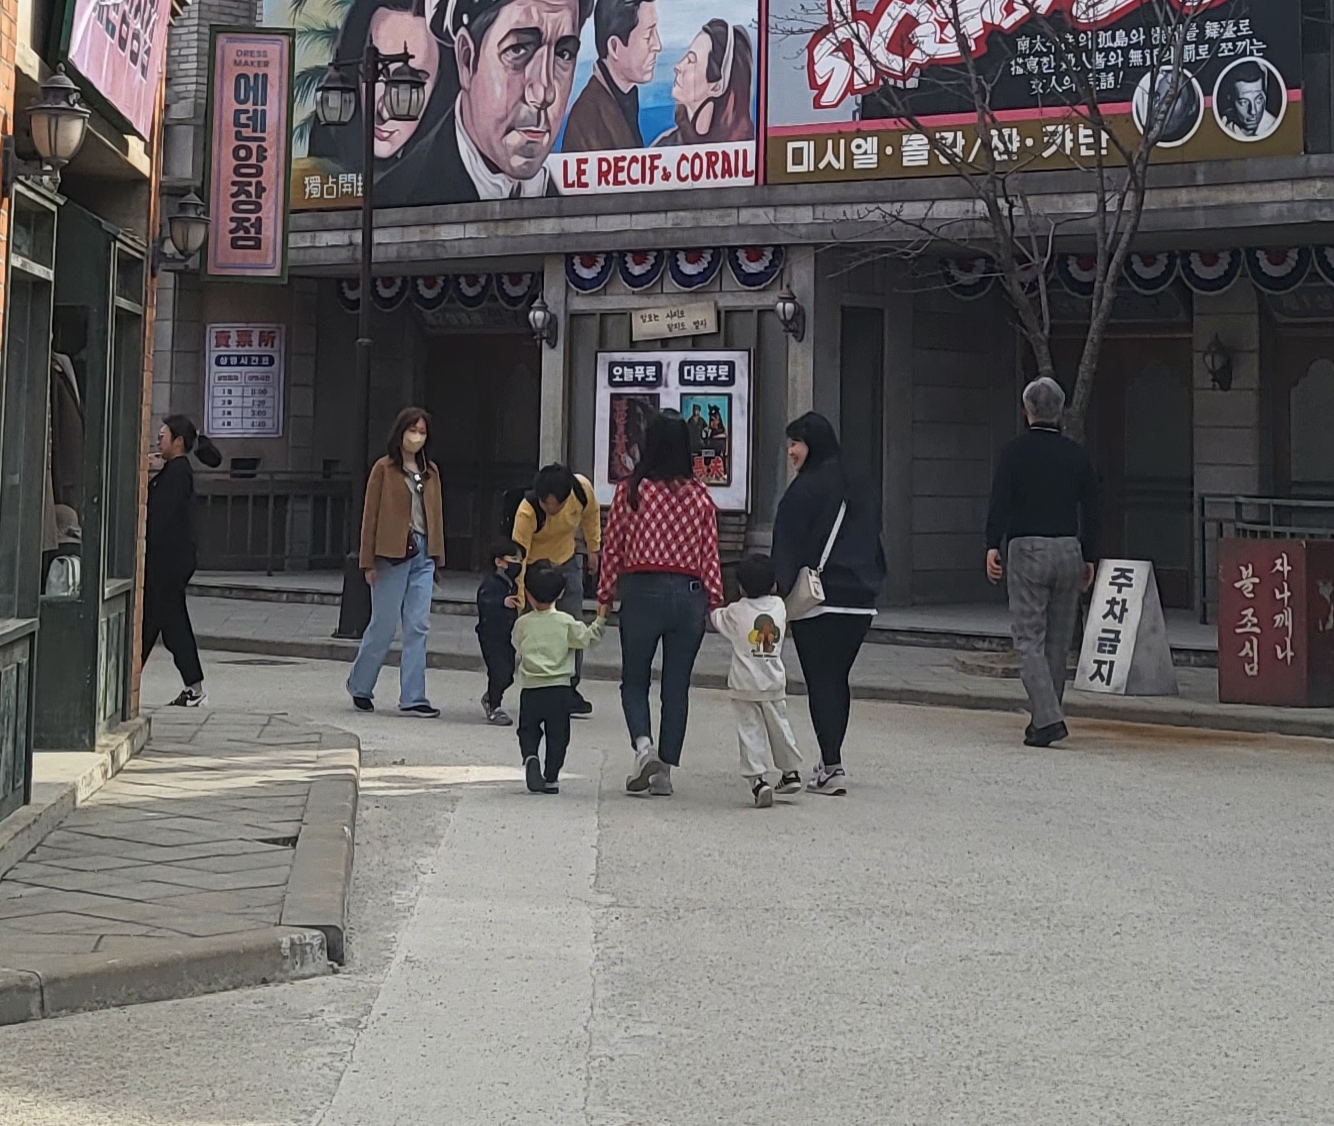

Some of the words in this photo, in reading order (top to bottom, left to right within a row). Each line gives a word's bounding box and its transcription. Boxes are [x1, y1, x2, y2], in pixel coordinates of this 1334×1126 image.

[232, 58, 270, 68] MAKER
[235, 48, 269, 58] DRESS
[228, 72, 269, 250] 에덴양장점
[562, 157, 590, 189] LE
[596, 153, 663, 187] RECIF
[676, 148, 755, 183] CORAIL
[612, 365, 657, 382] 오늘푸로
[683, 364, 730, 382] 다음푸로
[1088, 566, 1135, 687] 주차금지
[1233, 563, 1262, 676] 불조심
